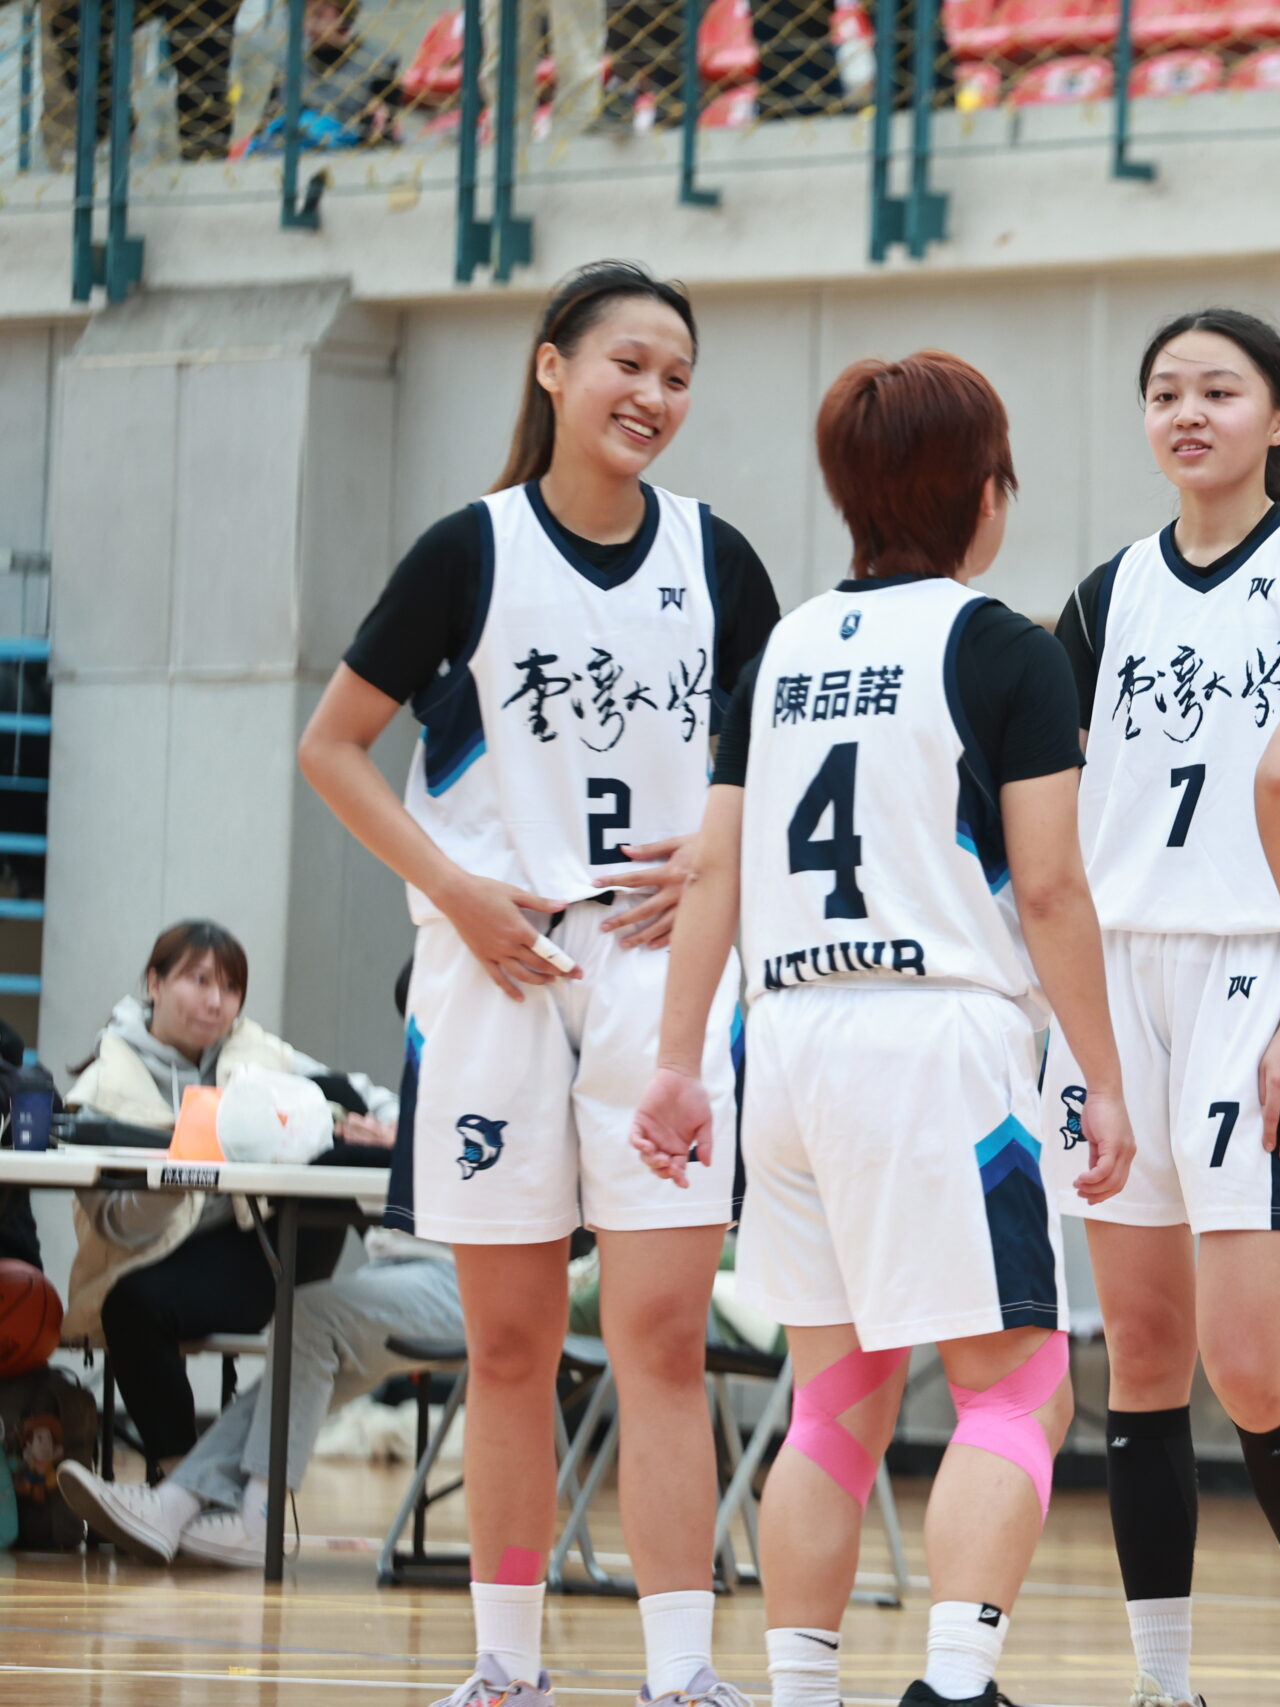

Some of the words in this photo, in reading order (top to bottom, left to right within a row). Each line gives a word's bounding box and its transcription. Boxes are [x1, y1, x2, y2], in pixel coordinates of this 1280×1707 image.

[772, 665, 905, 728] 陳品諾
[587, 777, 632, 866] 2
[787, 741, 868, 920] 4
[1166, 763, 1206, 848] 7
[1207, 1101, 1240, 1168] 7
